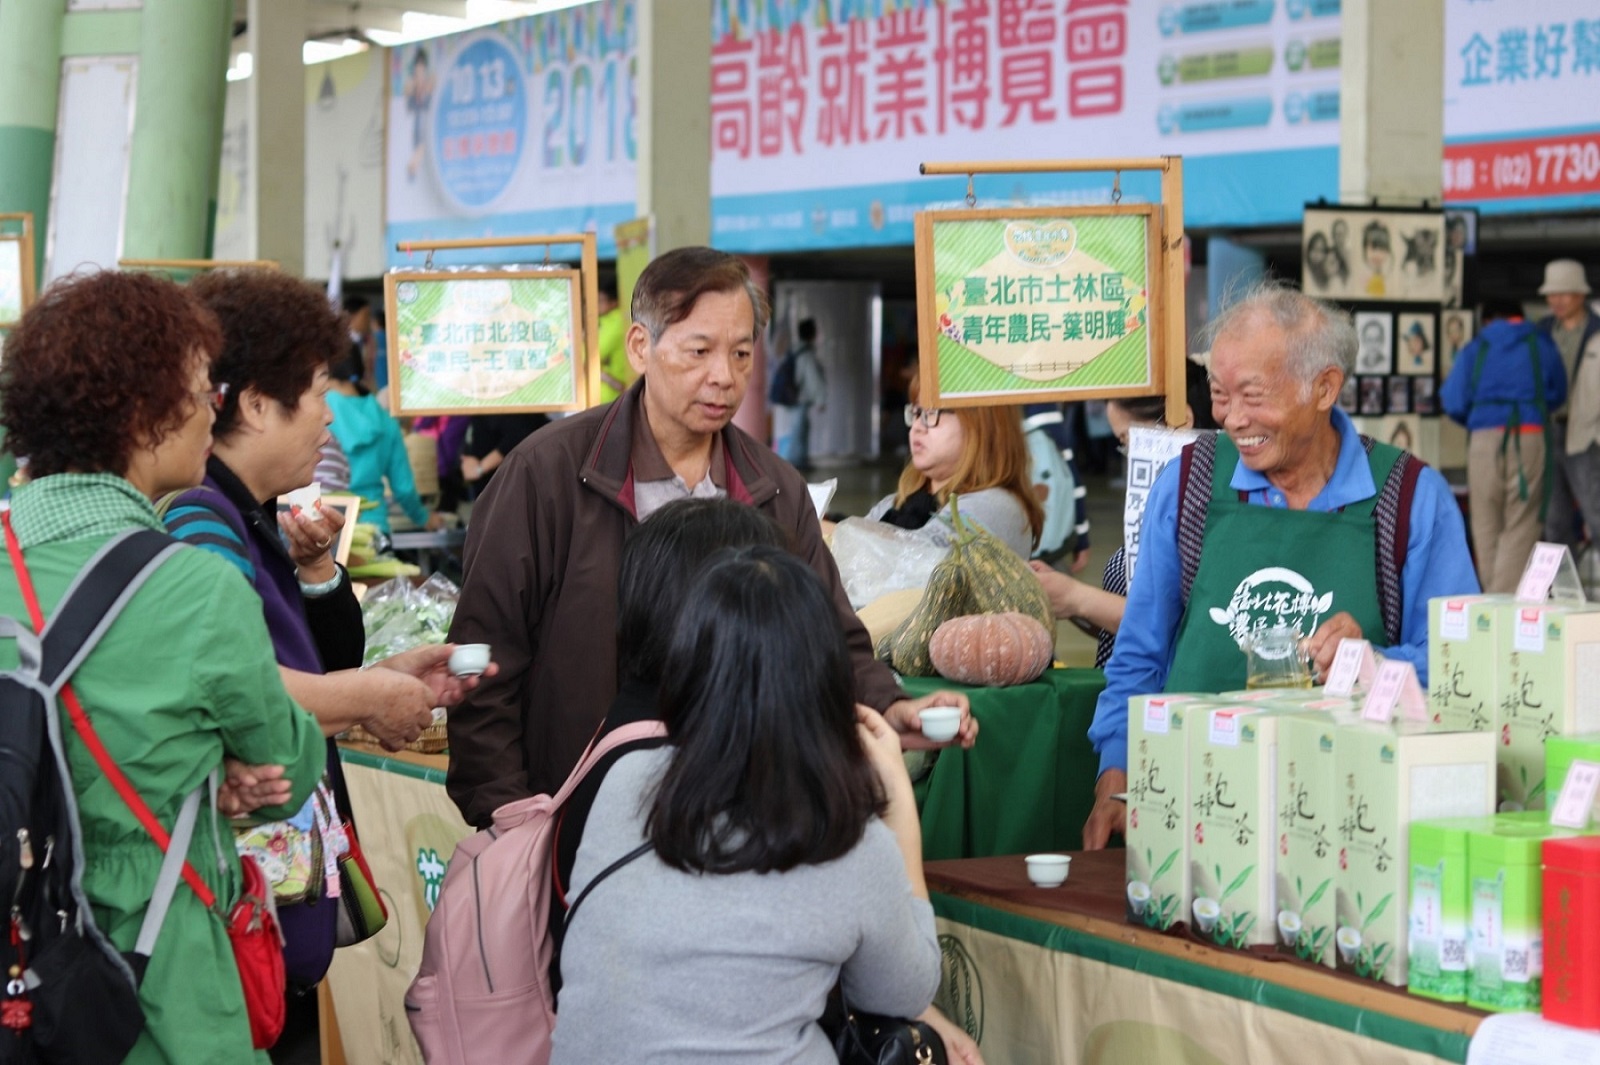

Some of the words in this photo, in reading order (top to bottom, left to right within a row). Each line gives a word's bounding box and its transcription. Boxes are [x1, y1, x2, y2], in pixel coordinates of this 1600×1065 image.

[711, 0, 1129, 159] 高齡就業博覽會
[962, 272, 1125, 306] 臺北市士林區
